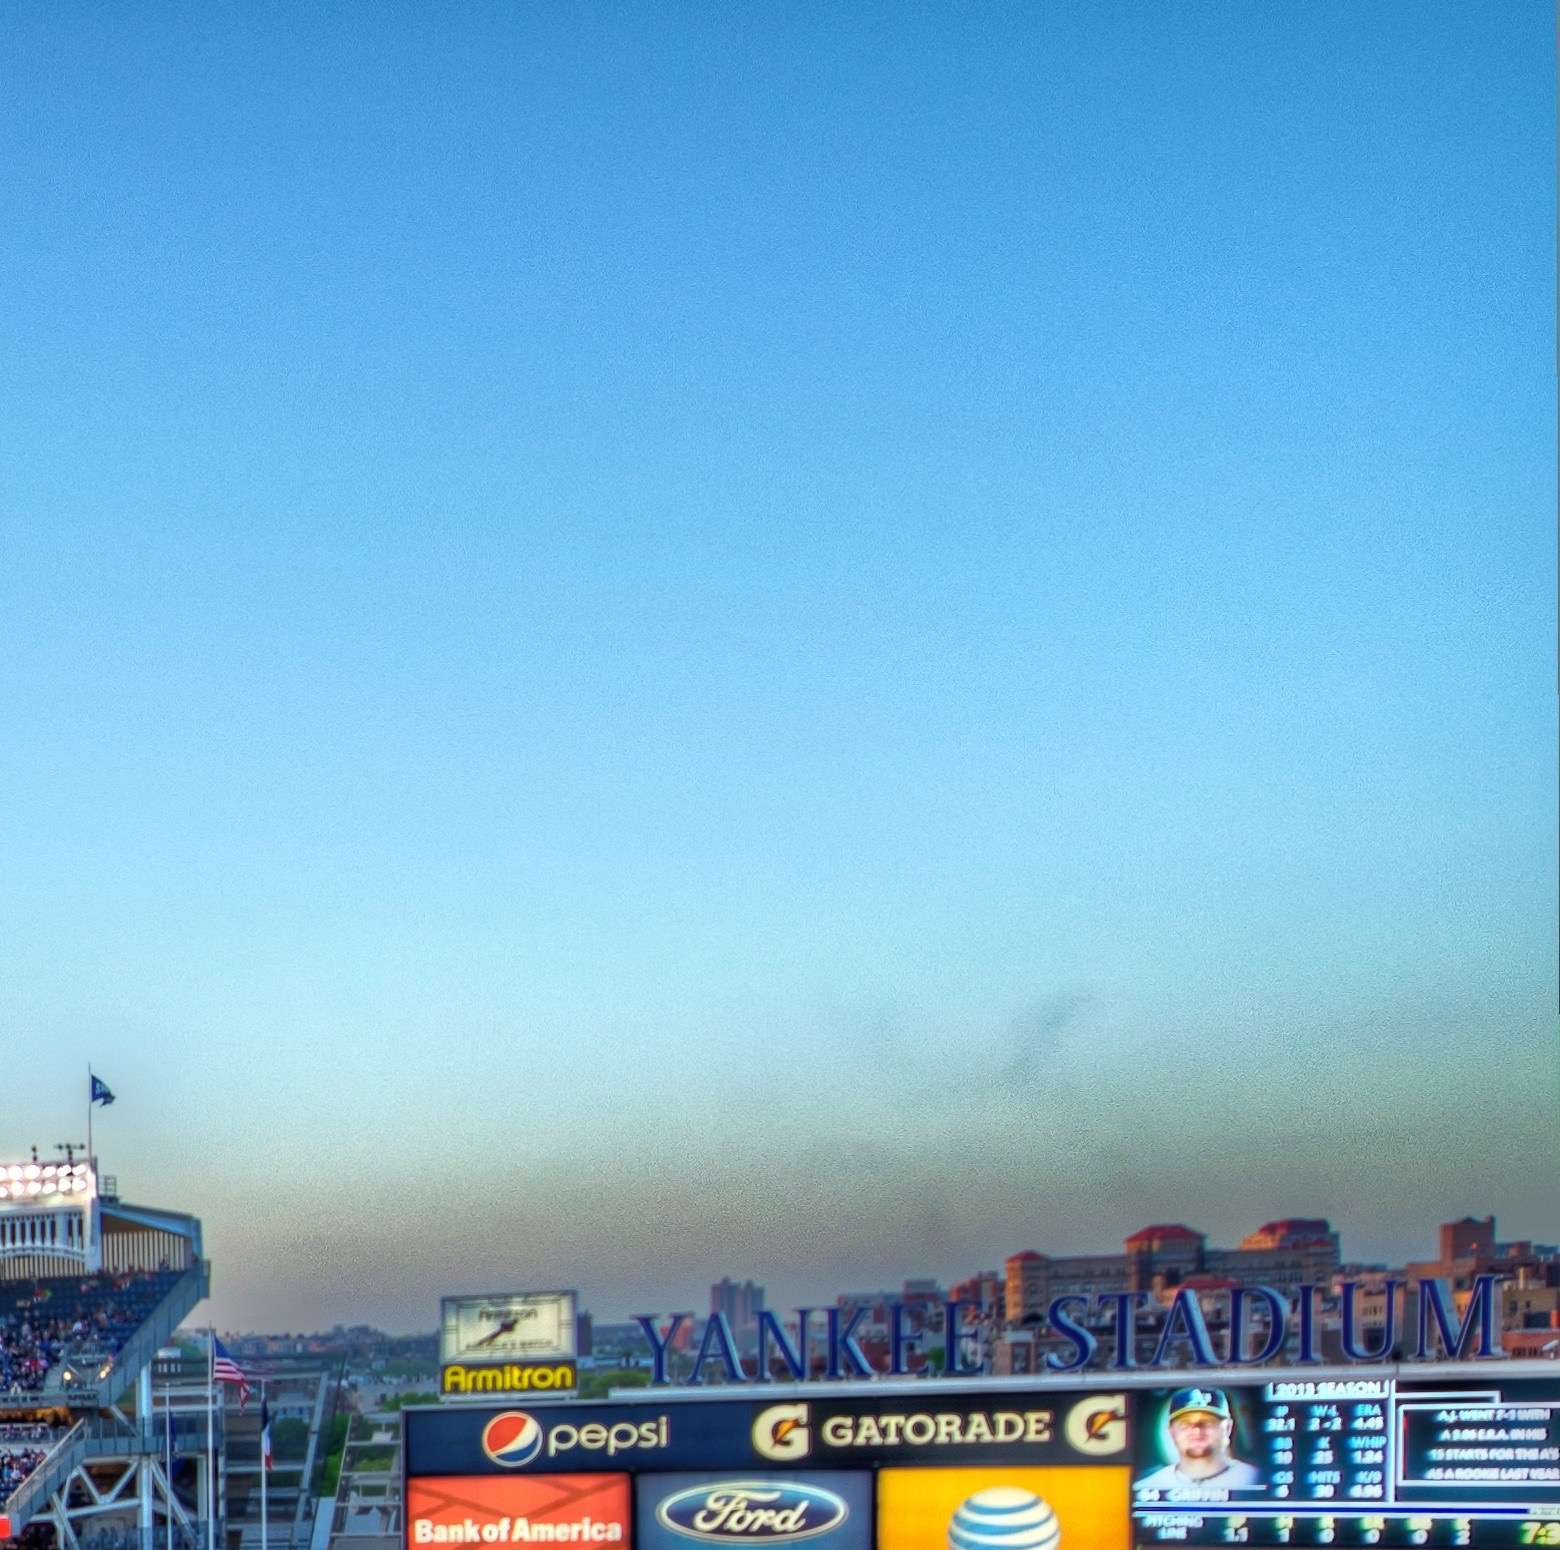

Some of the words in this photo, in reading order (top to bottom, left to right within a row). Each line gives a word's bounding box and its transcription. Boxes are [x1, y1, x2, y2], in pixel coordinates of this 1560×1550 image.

[631, 1298, 984, 1385] YANKEE
[1047, 1274, 1503, 1371] STADIUM
[443, 1364, 573, 1393] Armitron
[1318, 1382, 1381, 1394] SEASON
[547, 1415, 670, 1457] pepsi
[821, 1408, 1052, 1448] GATORADE
[1446, 1448, 1489, 1460] STARTS
[693, 1489, 806, 1534] Ford
[414, 1518, 480, 1544] Bank
[483, 1518, 512, 1543] of
[514, 1516, 622, 1543] America
